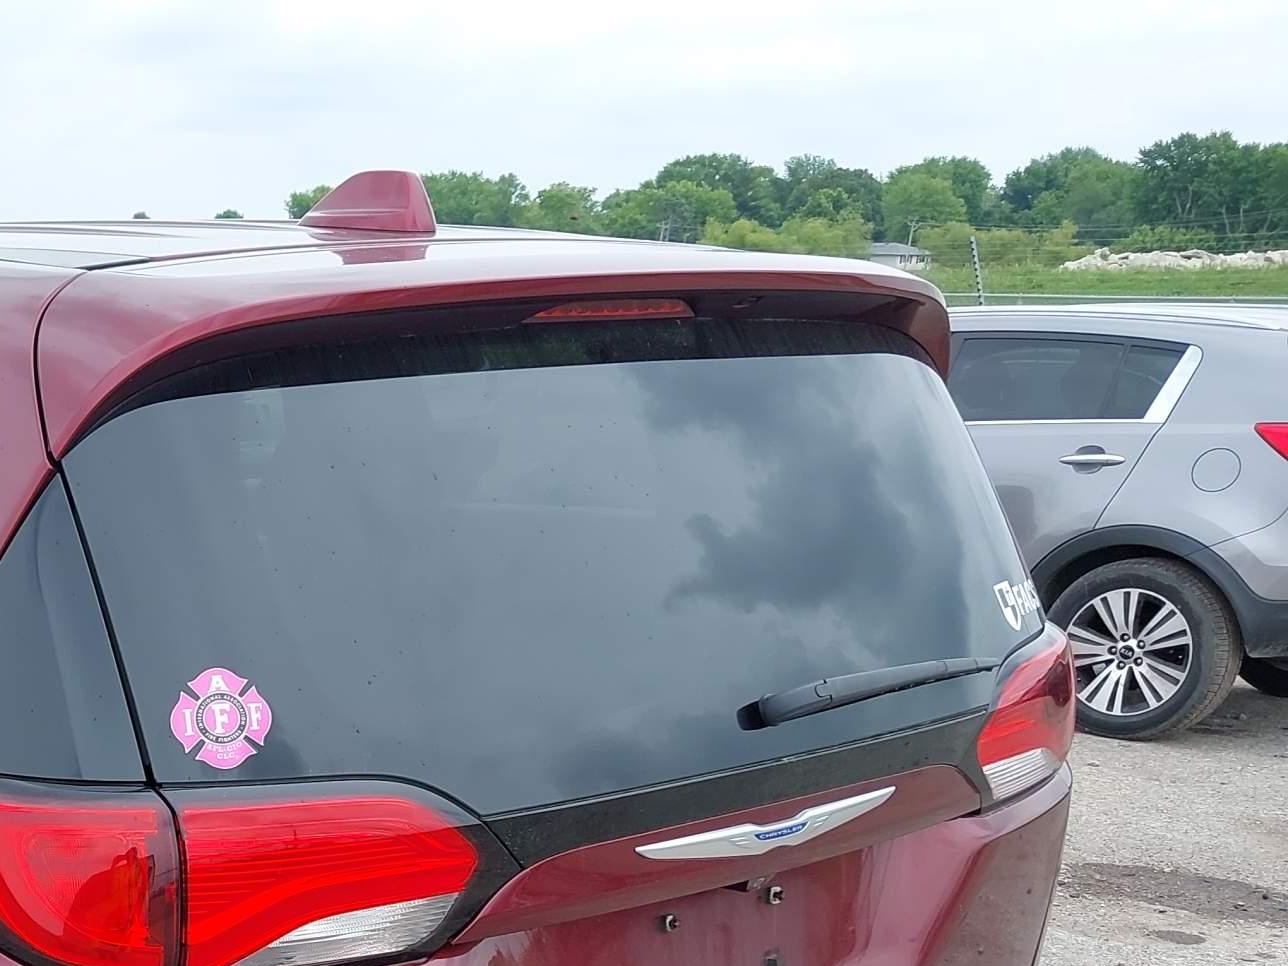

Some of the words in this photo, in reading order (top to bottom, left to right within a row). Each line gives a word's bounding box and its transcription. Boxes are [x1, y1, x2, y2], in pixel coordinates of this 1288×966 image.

[208, 675, 231, 694] A
[211, 702, 231, 735] F
[247, 702, 263, 731] F
[759, 824, 803, 839] CHRYSLER
